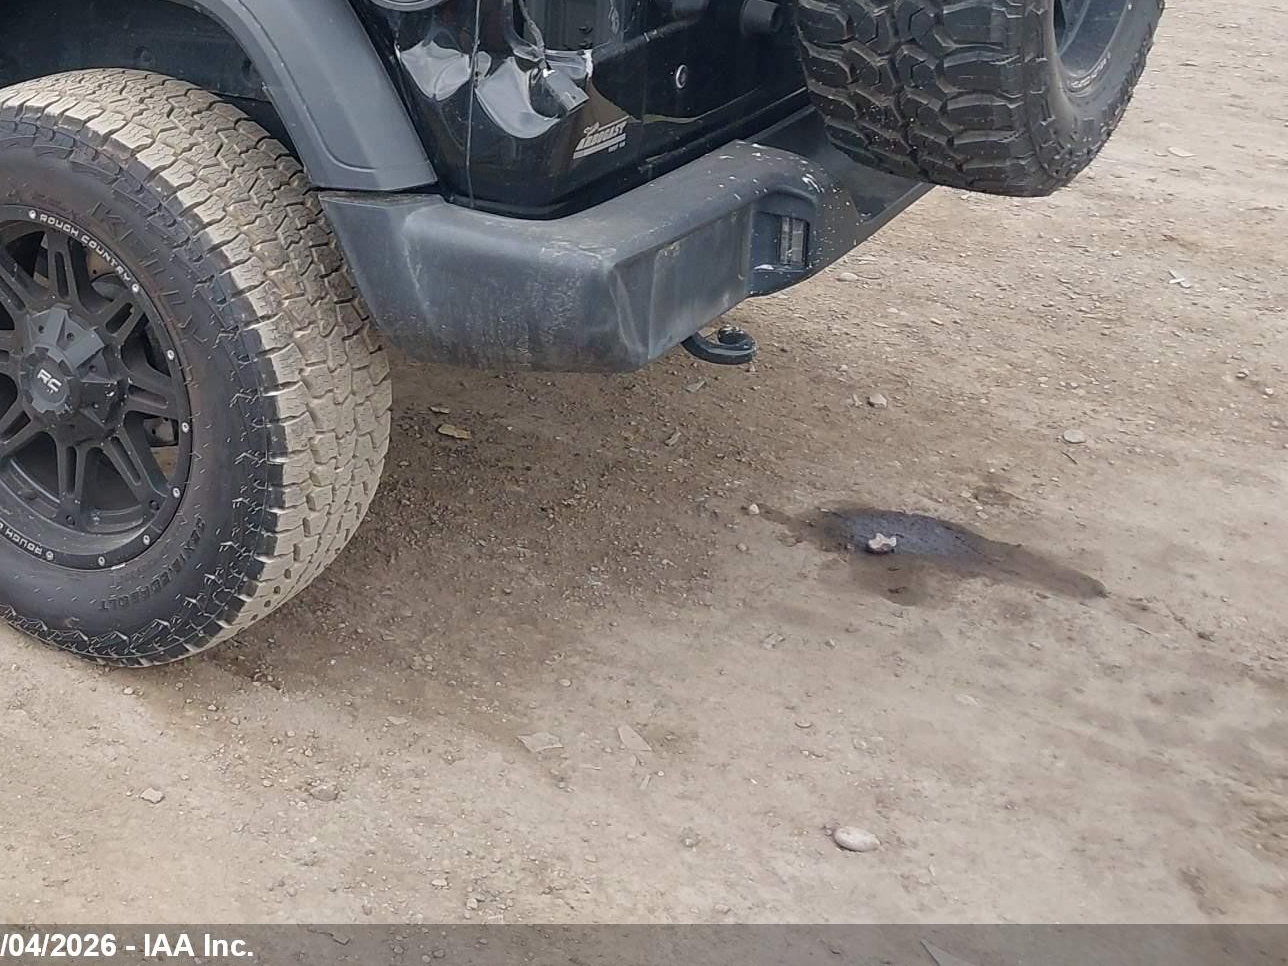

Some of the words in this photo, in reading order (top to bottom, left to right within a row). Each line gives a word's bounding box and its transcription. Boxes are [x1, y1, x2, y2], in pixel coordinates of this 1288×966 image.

[39, 212, 79, 237] ROUGH
[80, 231, 132, 284] COUNTRY
[37, 368, 62, 392] RC
[3, 525, 42, 556] ROUGH
